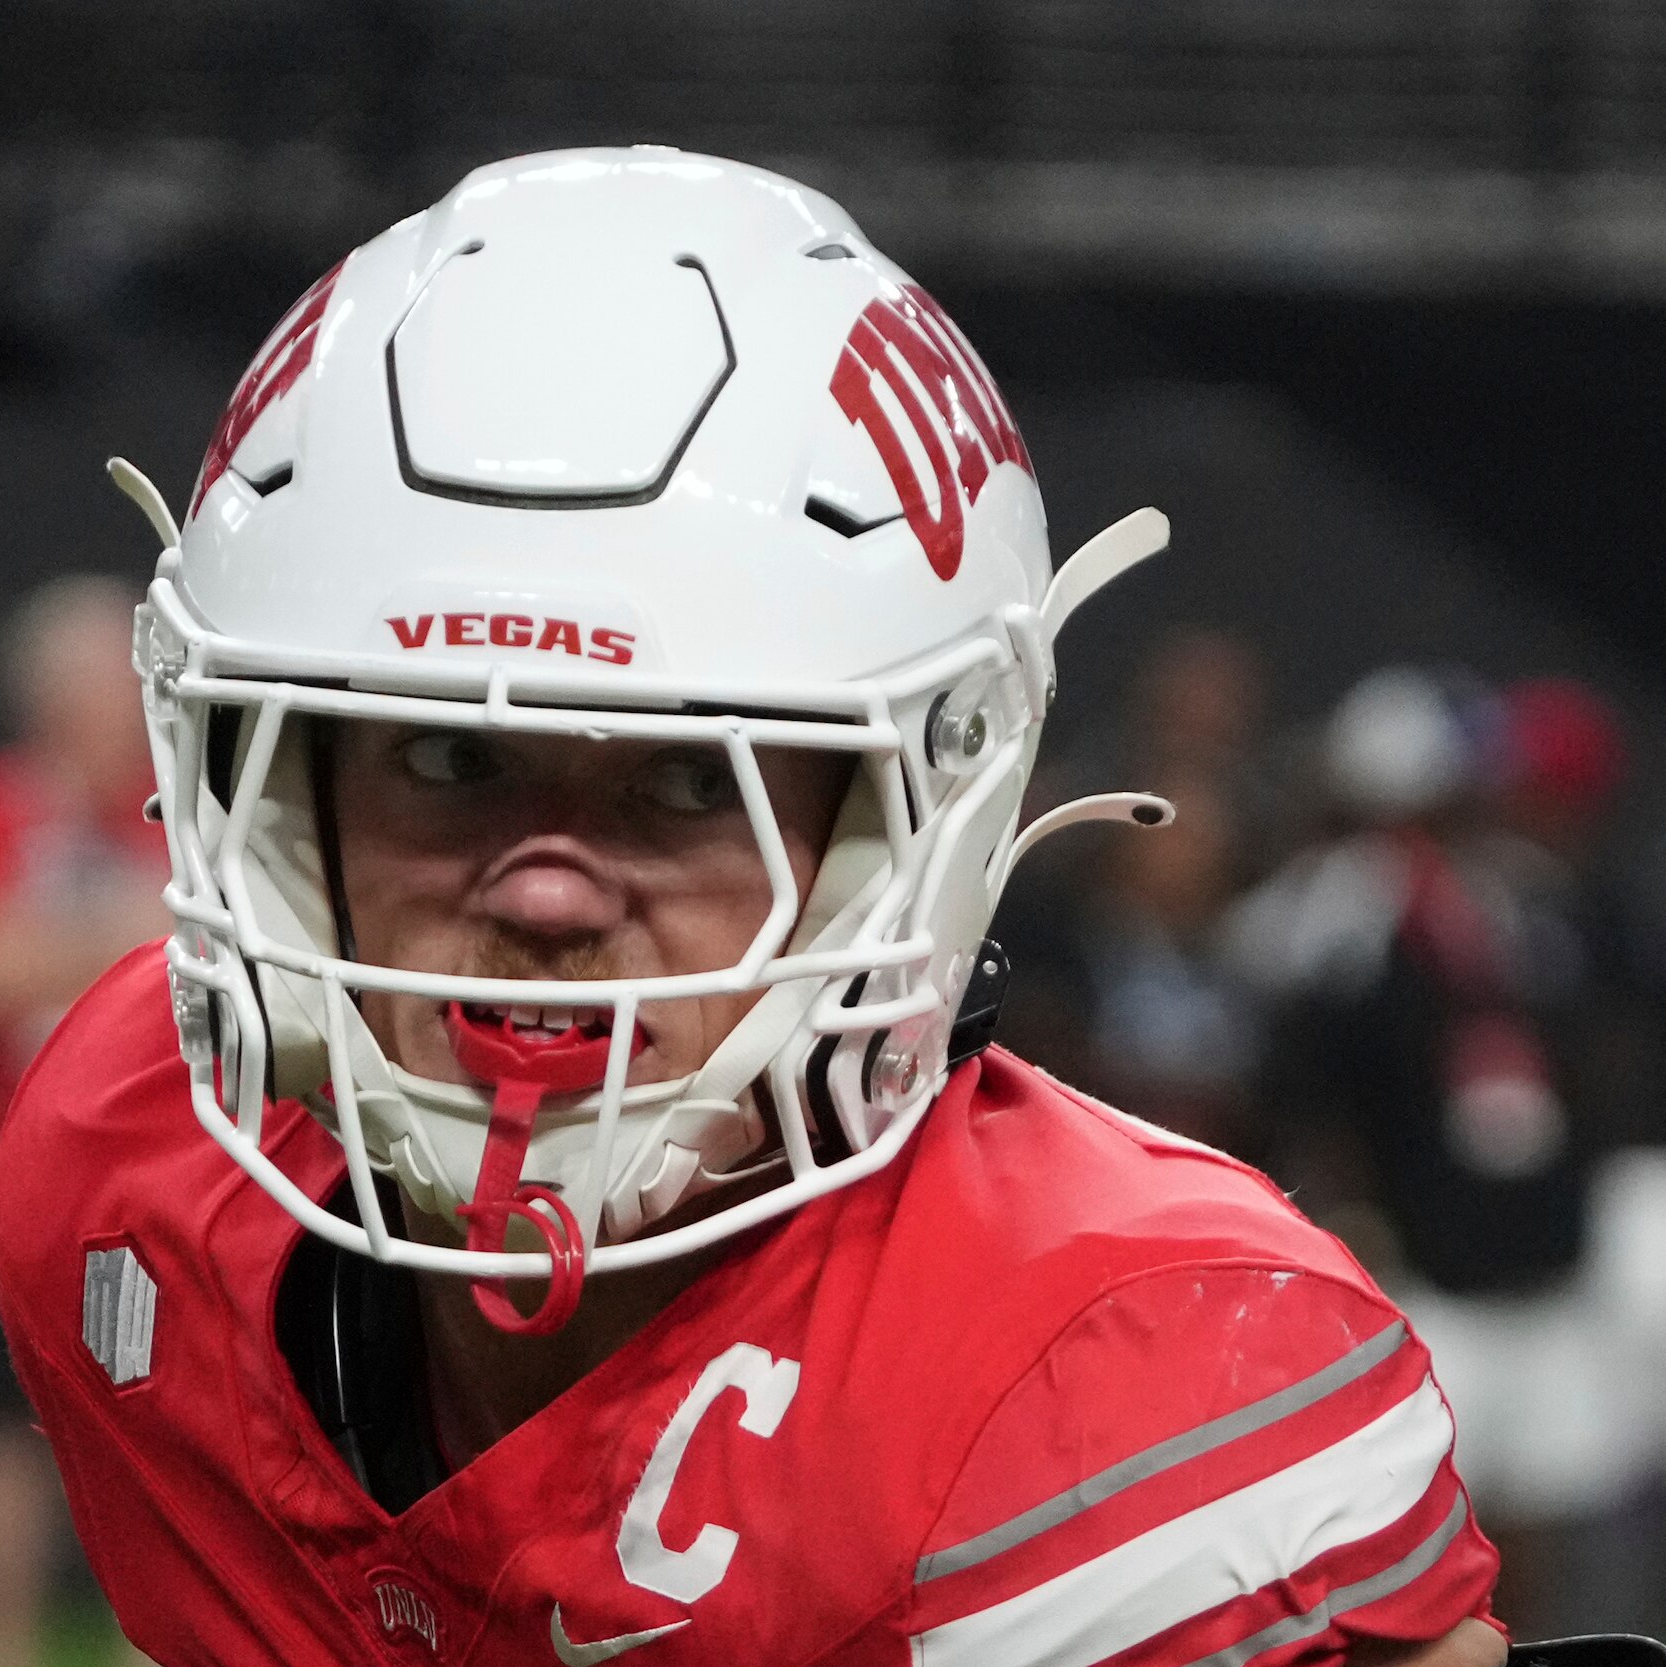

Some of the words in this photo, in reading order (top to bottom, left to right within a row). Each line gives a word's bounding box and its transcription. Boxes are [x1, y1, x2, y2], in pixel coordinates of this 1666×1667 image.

[383, 611, 636, 666] VEGAS
[616, 1341, 801, 1604] C
[374, 1583, 437, 1652] UNLV
